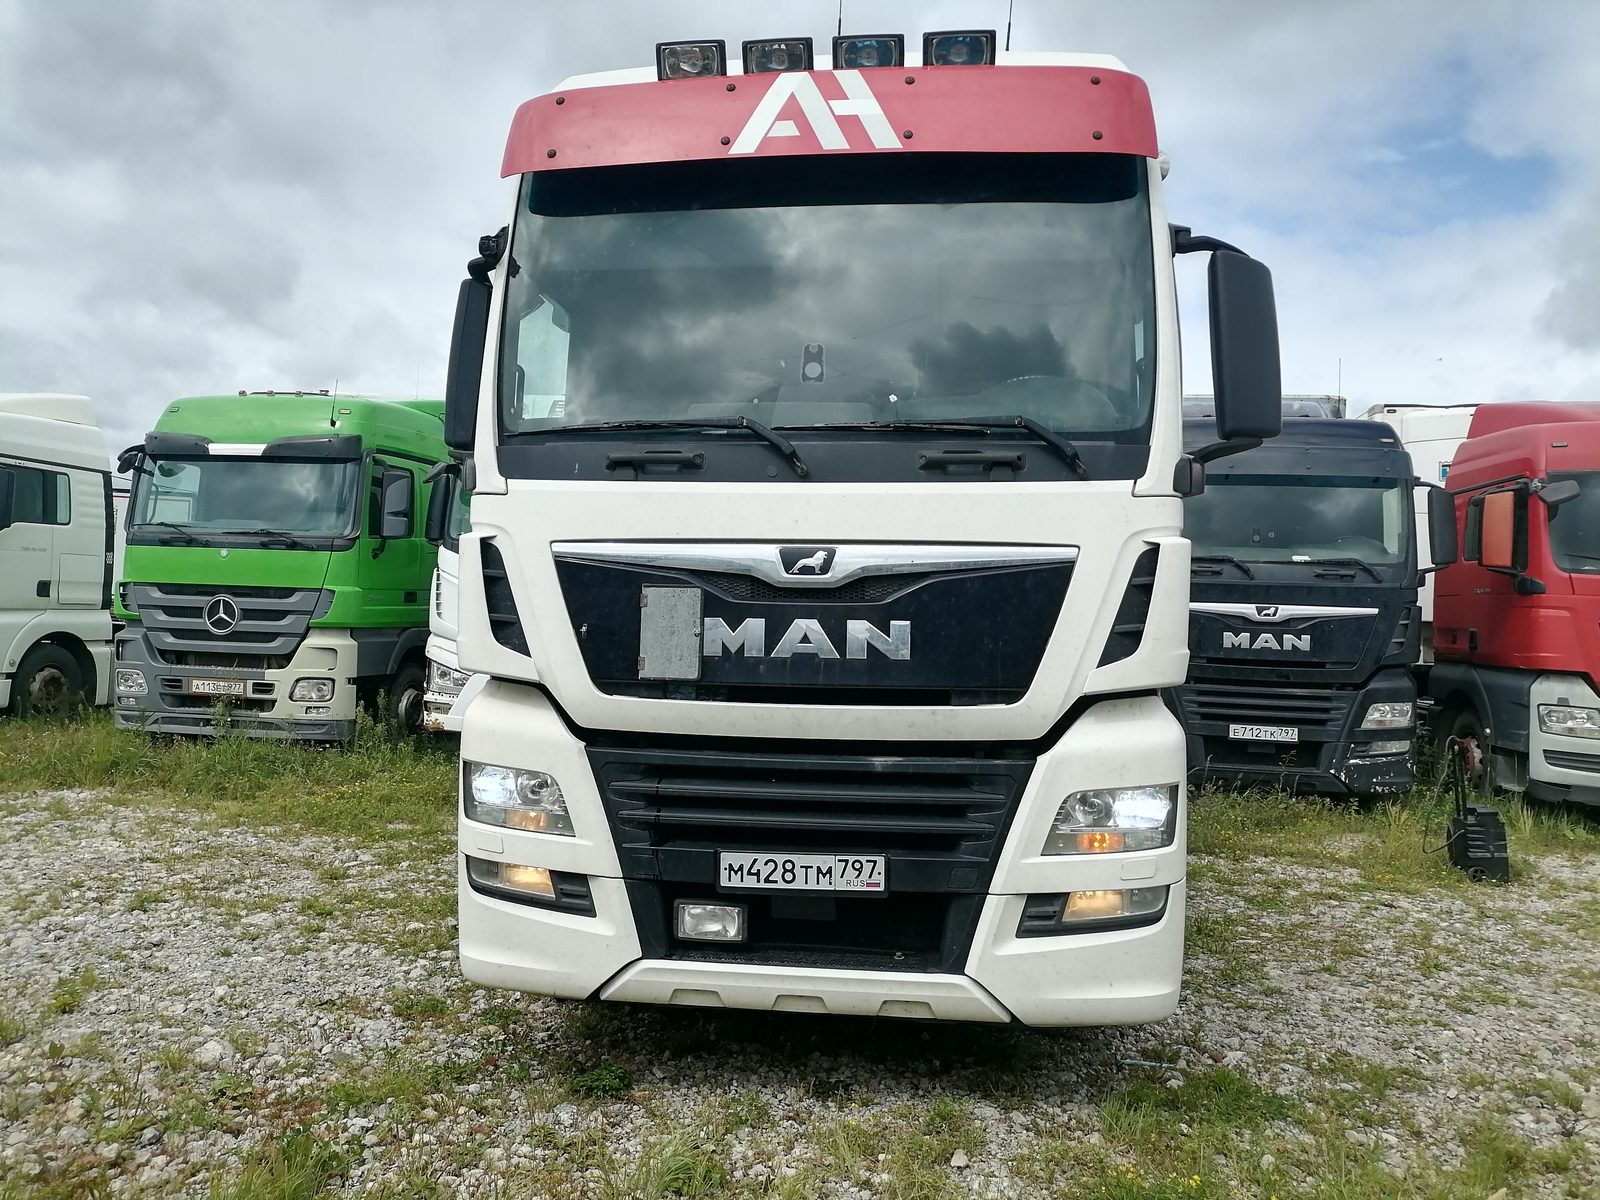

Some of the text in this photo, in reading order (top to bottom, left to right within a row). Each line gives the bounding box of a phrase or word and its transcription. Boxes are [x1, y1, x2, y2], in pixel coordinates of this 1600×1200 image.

[703, 617, 911, 660] MAN
[1223, 631, 1311, 651] MAN
[1278, 728, 1295, 738] 797
[728, 857, 878, 886] М428ТМ 797
[846, 879, 866, 888] RUS
